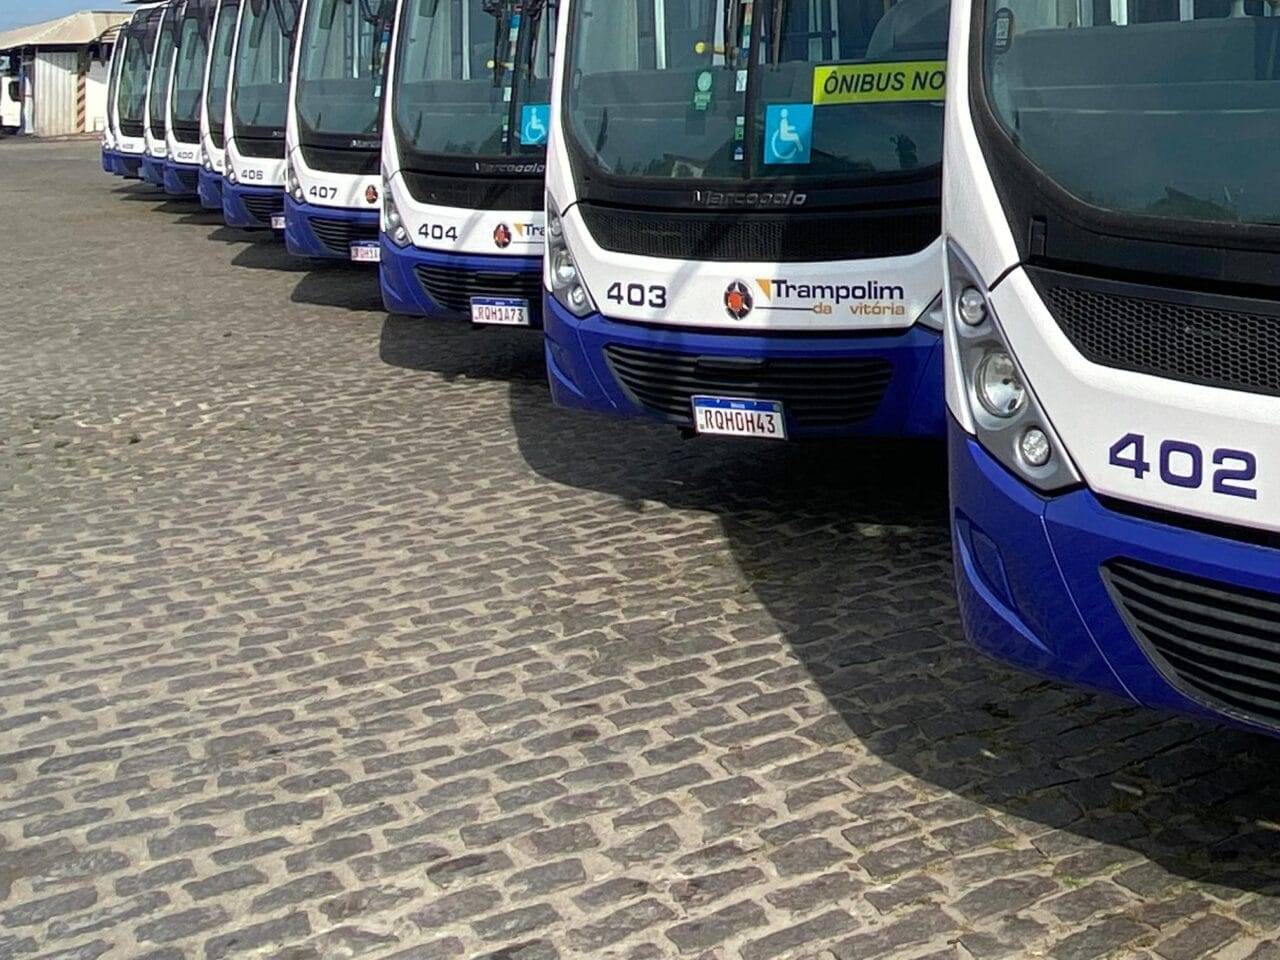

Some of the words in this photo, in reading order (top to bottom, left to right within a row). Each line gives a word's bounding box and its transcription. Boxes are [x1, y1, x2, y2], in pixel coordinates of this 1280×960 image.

[824, 71, 905, 94] ÔNIBUS
[309, 185, 338, 200] 407
[418, 223, 458, 242] 404
[607, 281, 667, 309] 403
[771, 279, 904, 305] Trampolim
[812, 301, 832, 315] da
[850, 300, 906, 316] vitória
[1108, 432, 1258, 500] 402
